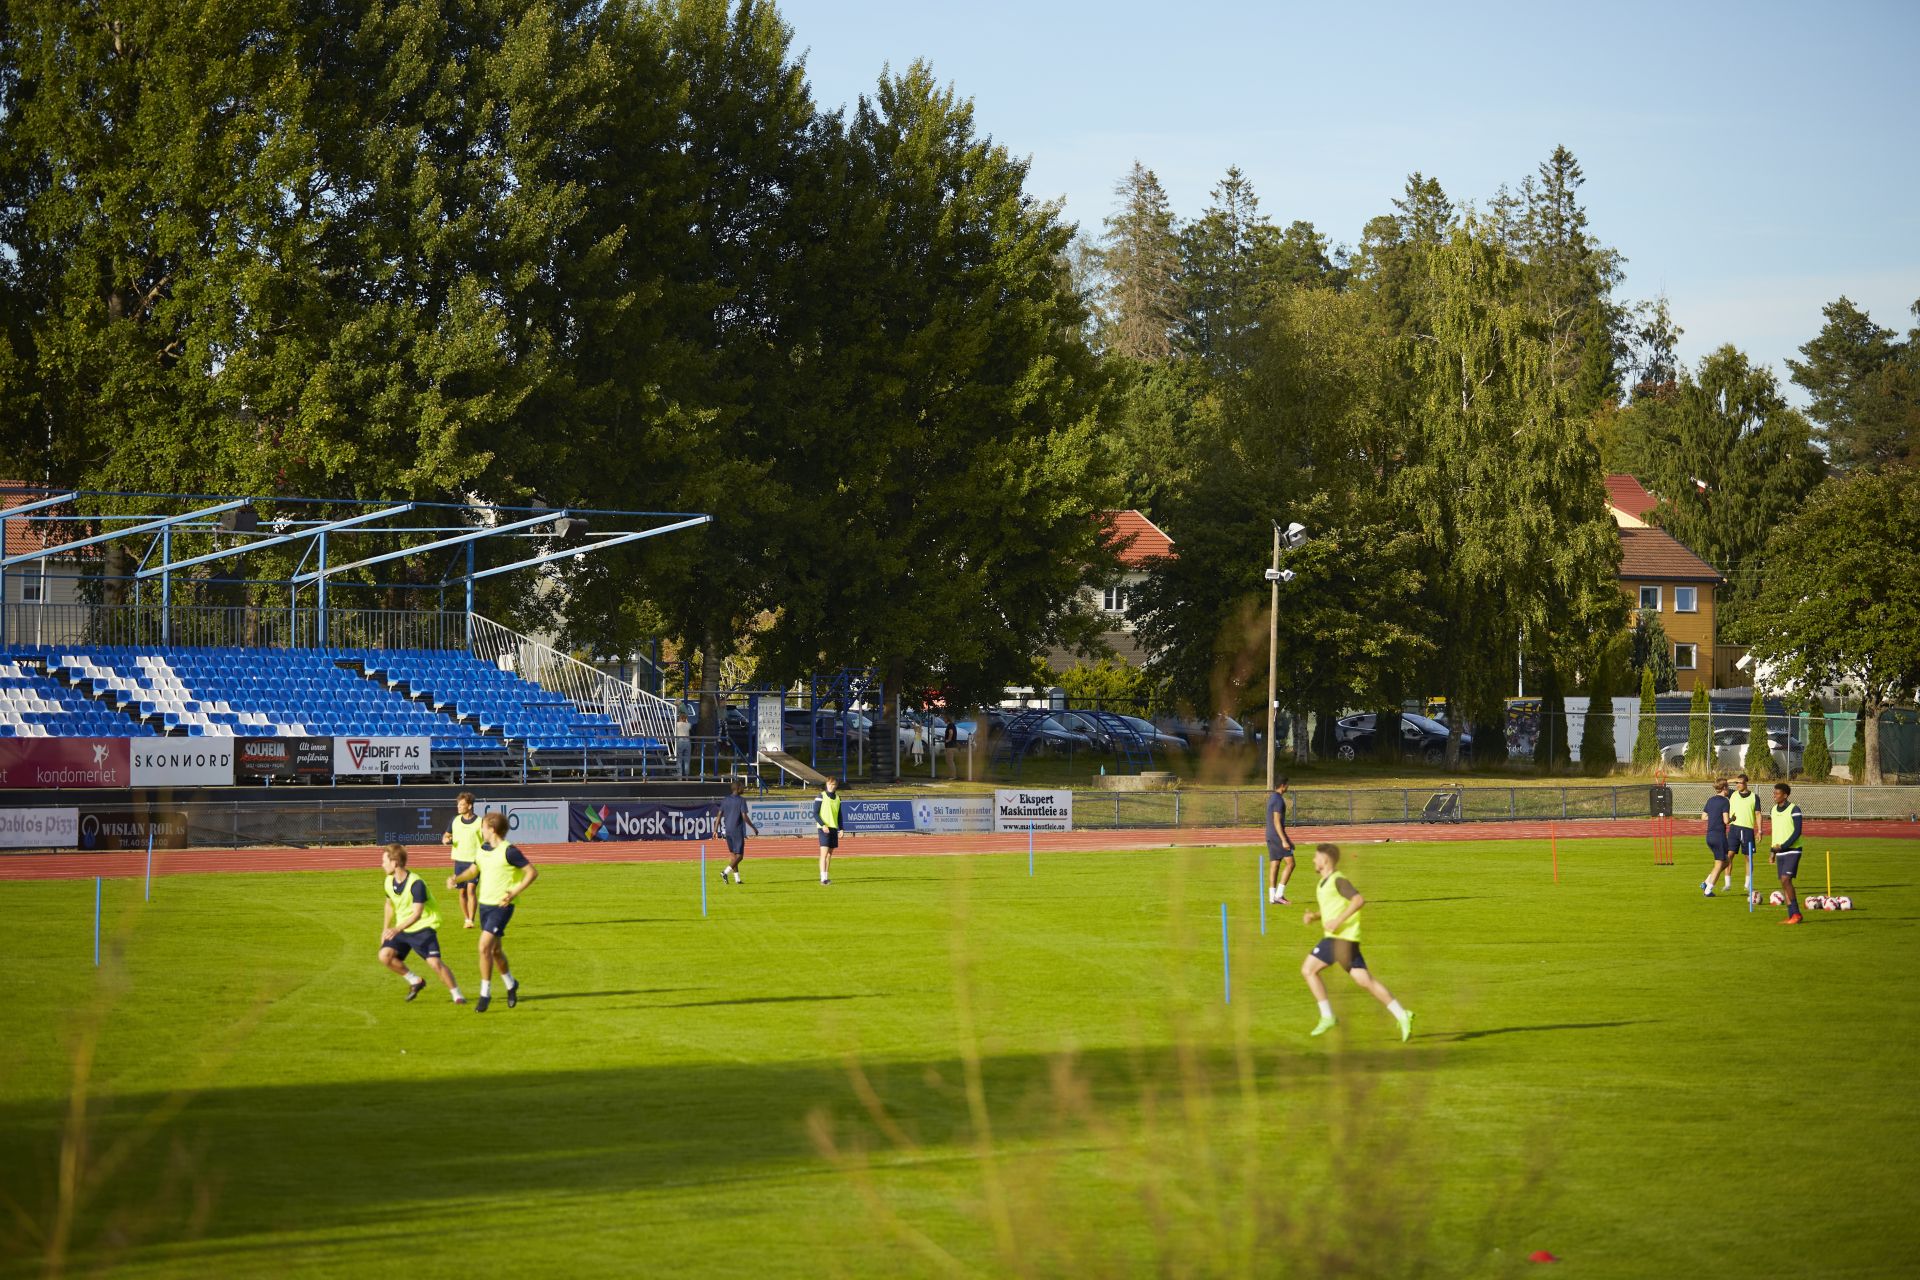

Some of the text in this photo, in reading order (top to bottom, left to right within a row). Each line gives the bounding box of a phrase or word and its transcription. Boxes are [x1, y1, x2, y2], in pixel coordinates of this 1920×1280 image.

[245, 742, 285, 757] SOLHEIM
[354, 746, 420, 758] VEIDRIFT AS
[390, 762, 420, 771] roadworks
[37, 766, 117, 783] kondomeriet
[1019, 793, 1054, 806] Ekspert
[862, 803, 889, 811] EKSPERT
[933, 806, 944, 815] Ski
[1000, 805, 1068, 816] Maskinutleie as
[751, 811, 815, 821] FOLLO AUTOC
[847, 812, 901, 821] MASKINUTLEIE AS
[615, 810, 666, 835] Norsk
[384, 832, 442, 841] EIE eiendomsm
